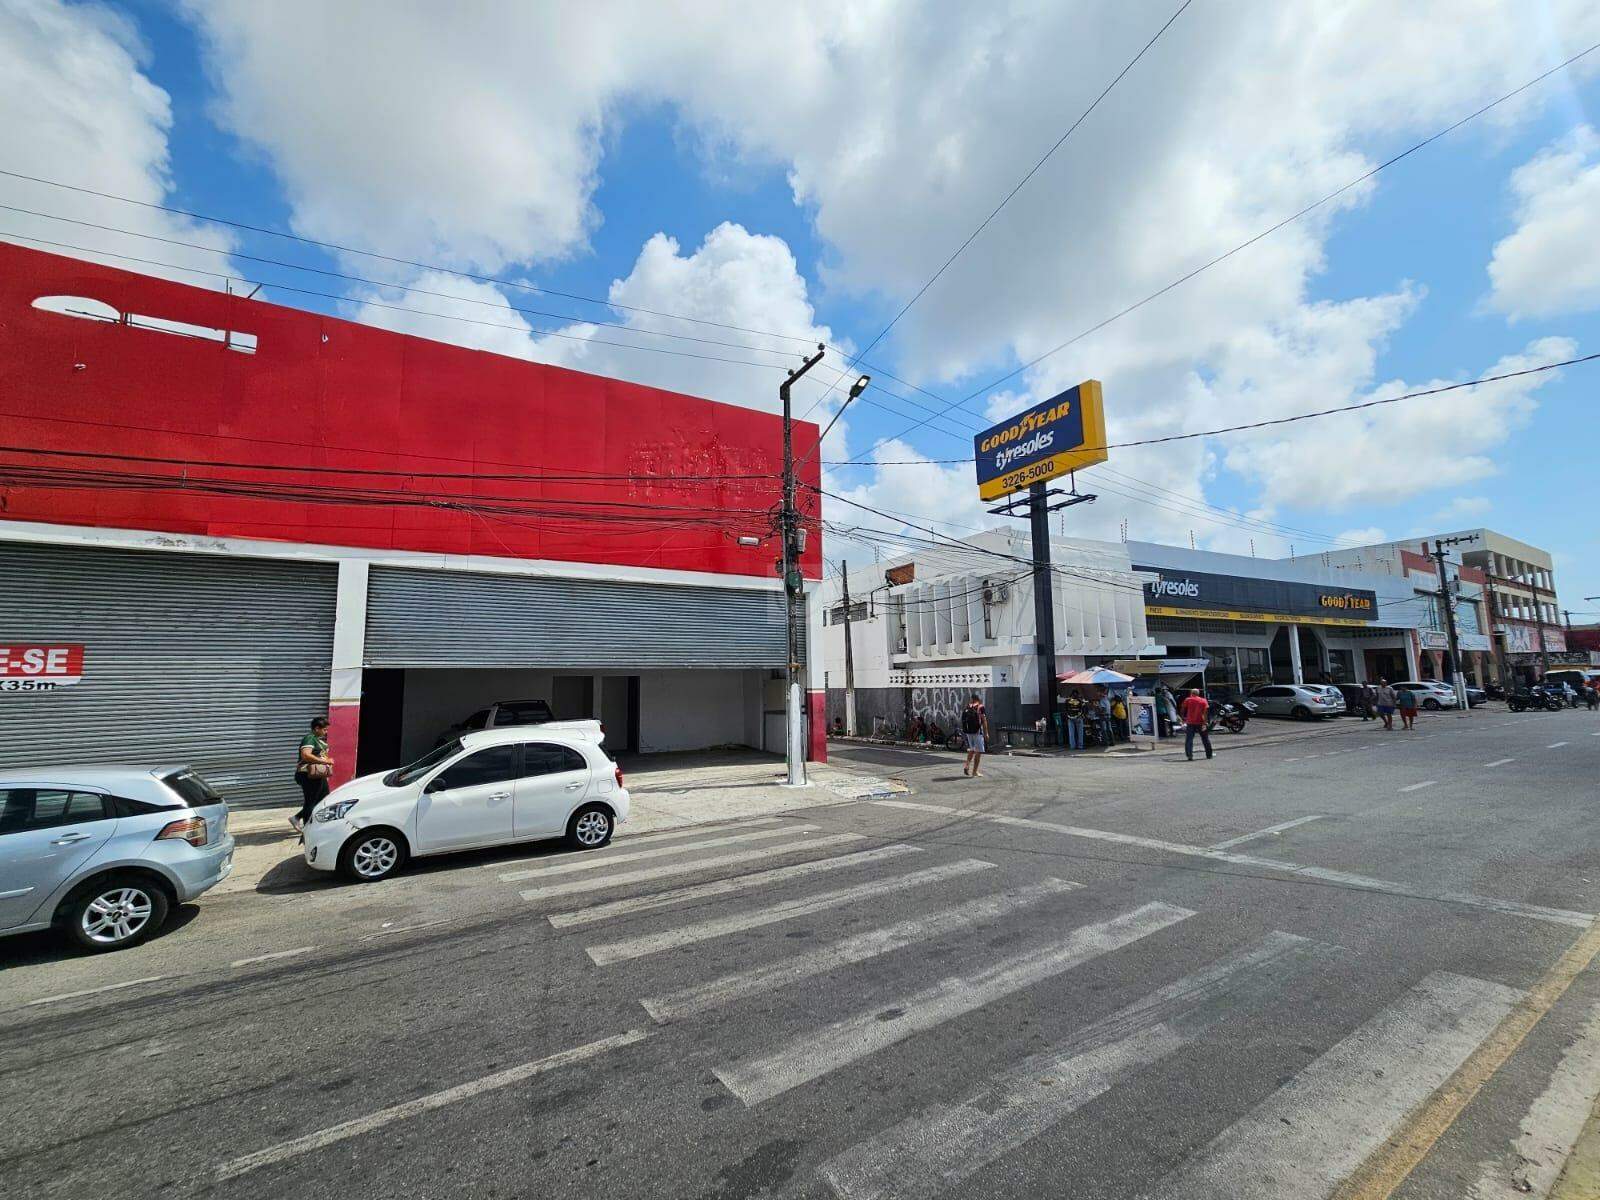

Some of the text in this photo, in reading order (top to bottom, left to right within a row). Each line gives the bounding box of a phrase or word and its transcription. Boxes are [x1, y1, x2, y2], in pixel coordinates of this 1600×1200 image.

[981, 400, 1071, 453] GOODYEAR
[995, 430, 1055, 471] tyresoles
[1002, 460, 1054, 489] 3226-5000
[1321, 593, 1371, 609] GOODYEAR
